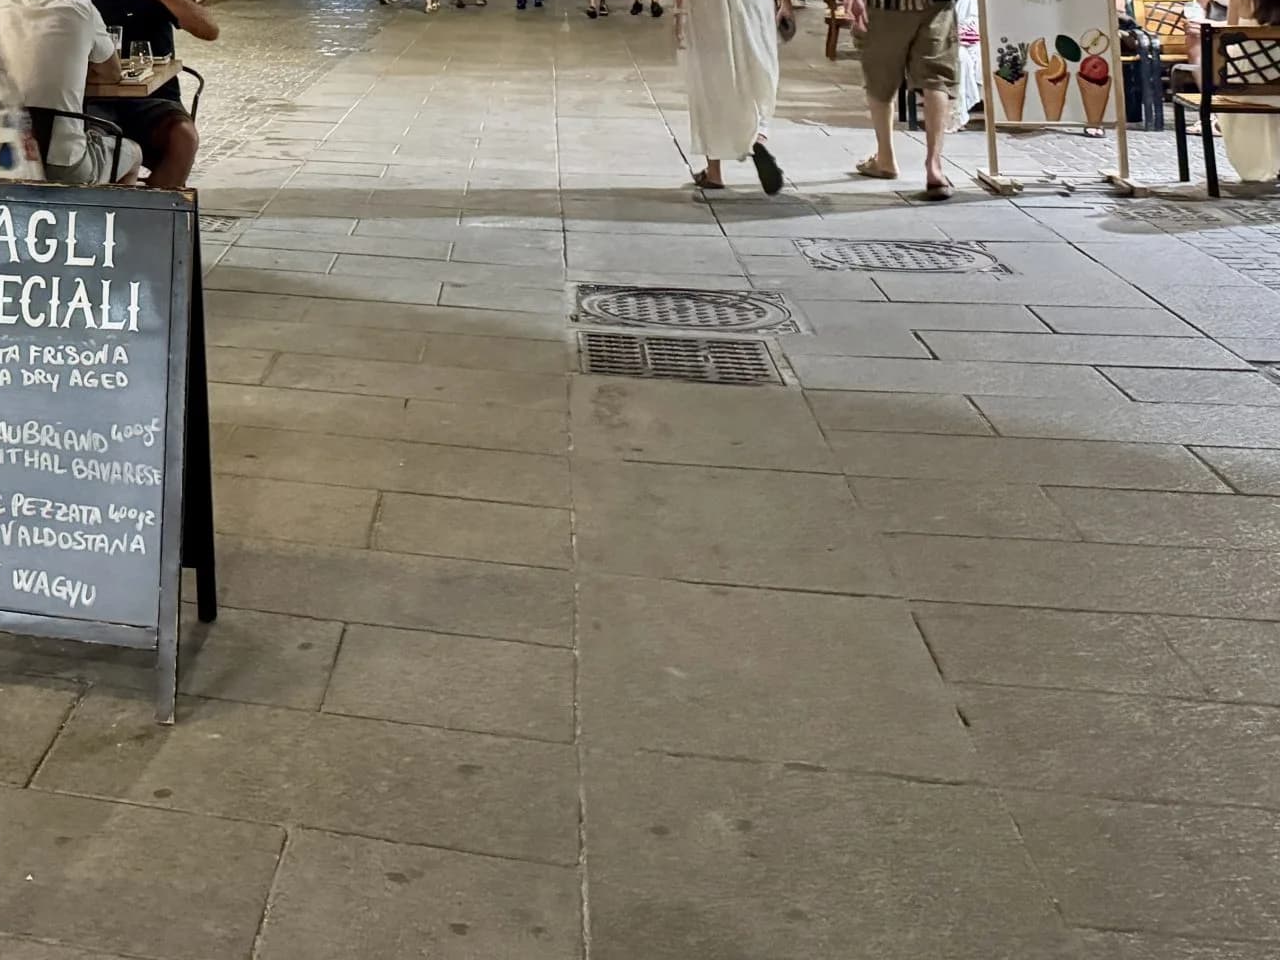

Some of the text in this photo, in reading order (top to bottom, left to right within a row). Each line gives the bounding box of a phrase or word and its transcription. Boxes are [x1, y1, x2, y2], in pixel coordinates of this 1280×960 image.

[69, 369, 129, 388] AGED
[72, 458, 162, 486] BAVARESE
[11, 493, 103, 525] PEZZATA
[0, 521, 146, 555] VALDOSTANA
